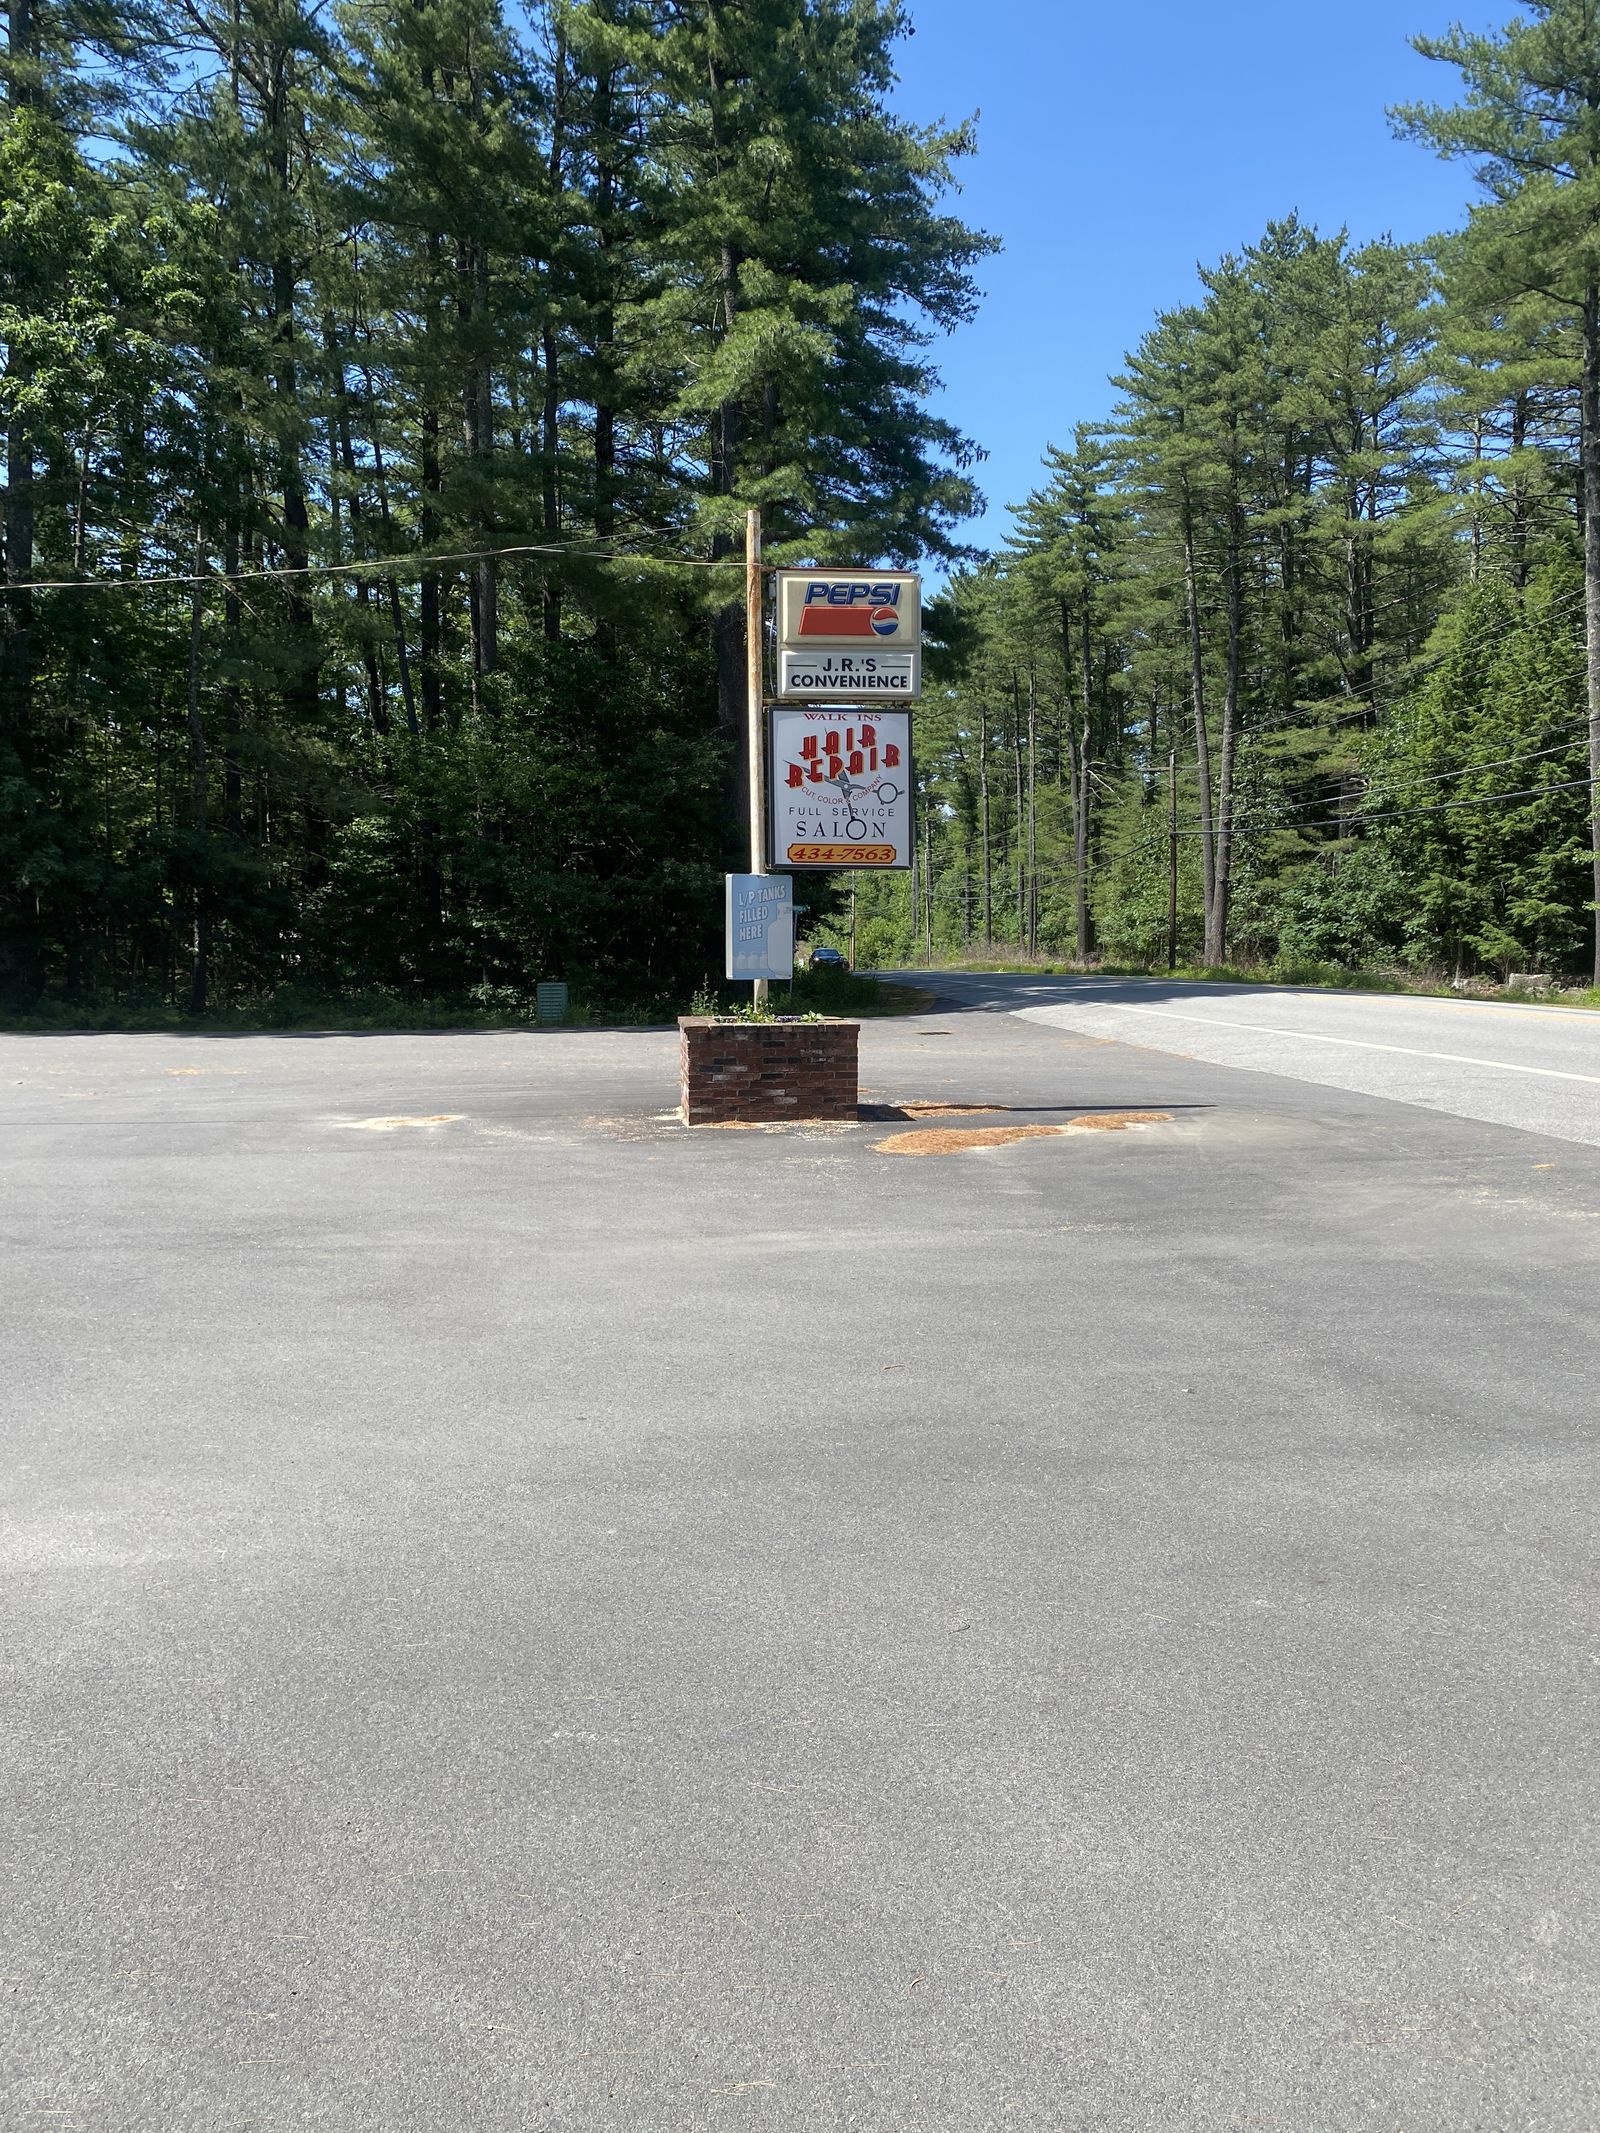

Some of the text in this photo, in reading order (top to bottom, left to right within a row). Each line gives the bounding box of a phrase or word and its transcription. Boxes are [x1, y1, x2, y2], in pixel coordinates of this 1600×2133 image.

[805, 582, 901, 605] PEPSI
[823, 658, 877, 672] J.R.'S
[791, 675, 907, 688] CONVENIENCE
[804, 713, 847, 721] WALK
[799, 724, 876, 760] HAIR
[785, 744, 900, 788] REPAIR
[817, 795, 844, 805] COLOR
[852, 774, 882, 801] COMPANY
[789, 807, 895, 817] FULL SERVICE
[796, 820, 886, 840] SALON
[793, 848, 892, 861] 434-7563
[758, 885, 786, 903] TANKS
[739, 906, 768, 924] FILLED
[739, 924, 763, 942] HERE
